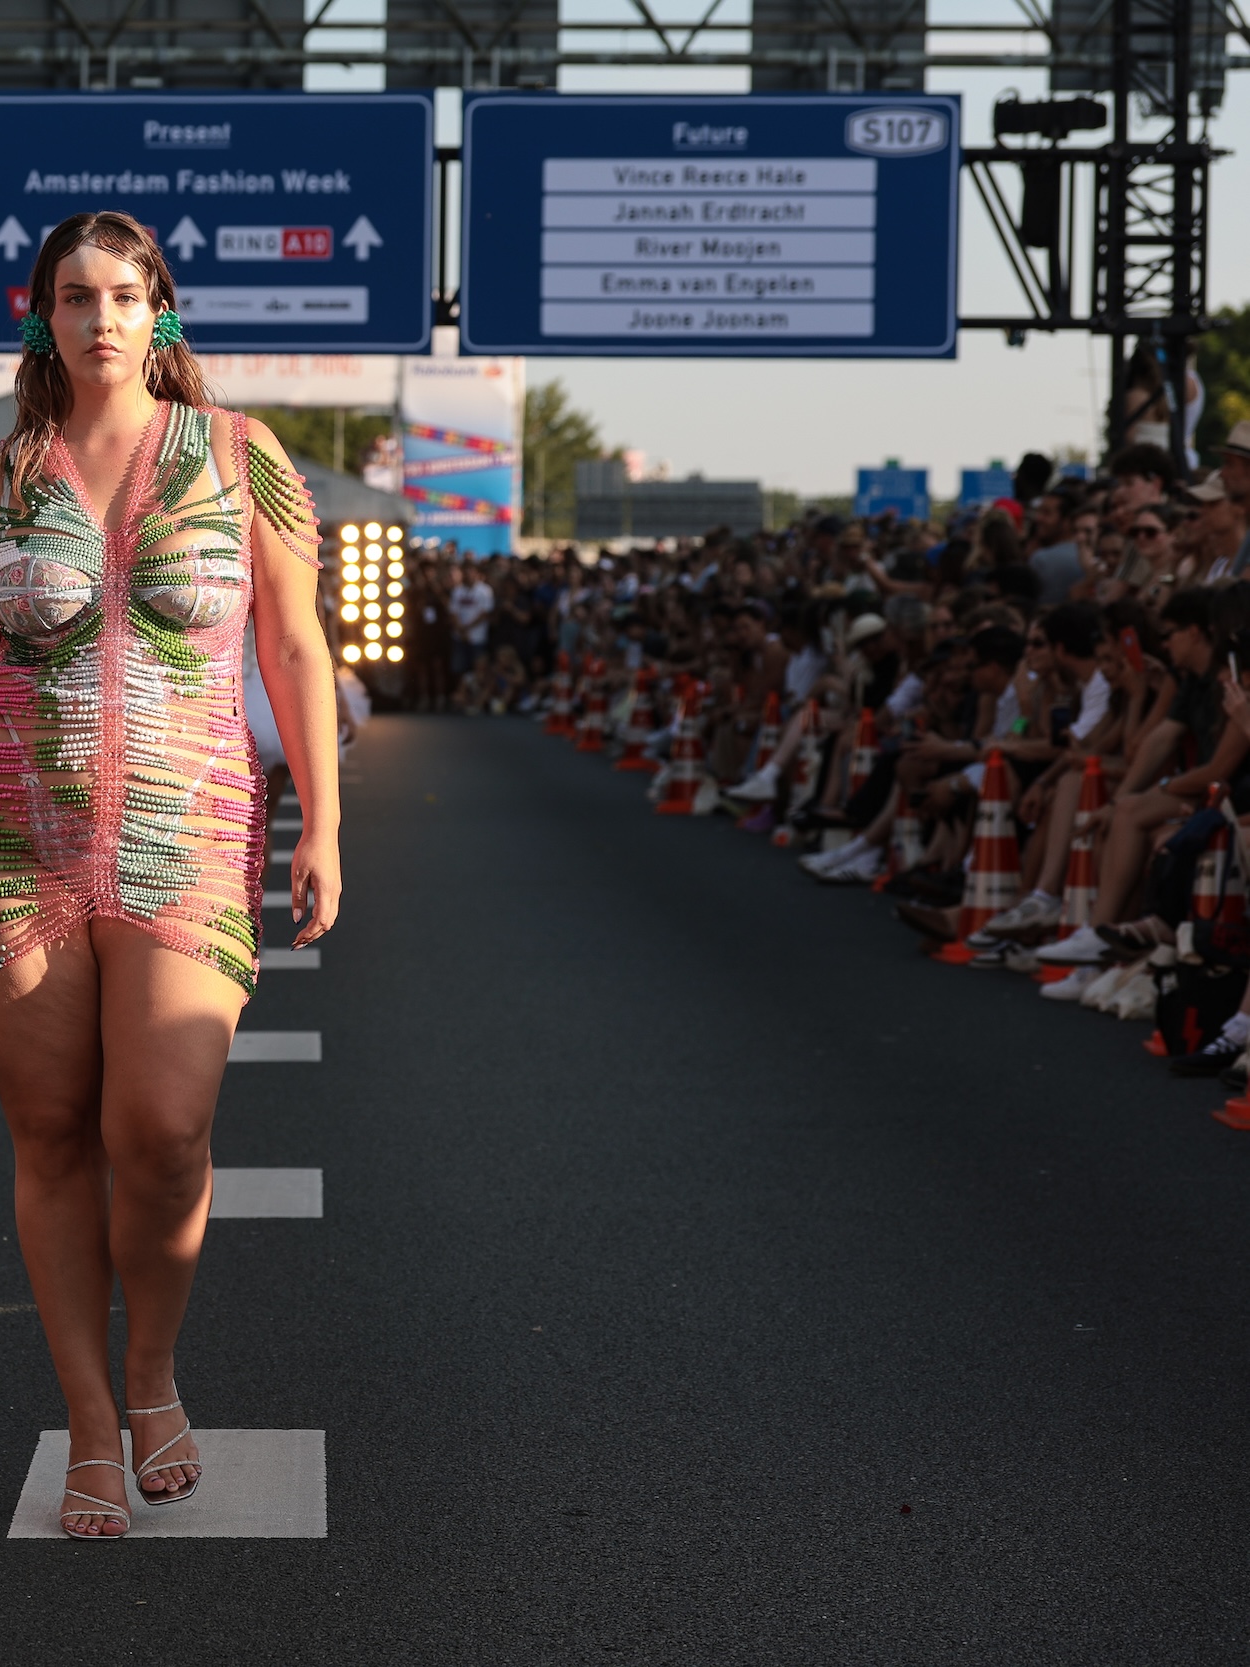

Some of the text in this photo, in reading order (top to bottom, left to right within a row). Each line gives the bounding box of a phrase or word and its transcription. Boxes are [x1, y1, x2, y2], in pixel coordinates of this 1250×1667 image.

[143, 121, 231, 141] Present
[673, 122, 748, 143] Future
[862, 118, 932, 144] S107
[24, 169, 350, 194] Amsterdam Fashion Week
[613, 166, 807, 187] Vince Reece Hale
[612, 202, 806, 223] Jannah Erdtracht
[220, 233, 326, 254] RING A10
[635, 237, 694, 258] River
[600, 273, 815, 299] Emma van Engelen
[627, 309, 790, 331] Joone Joonam
